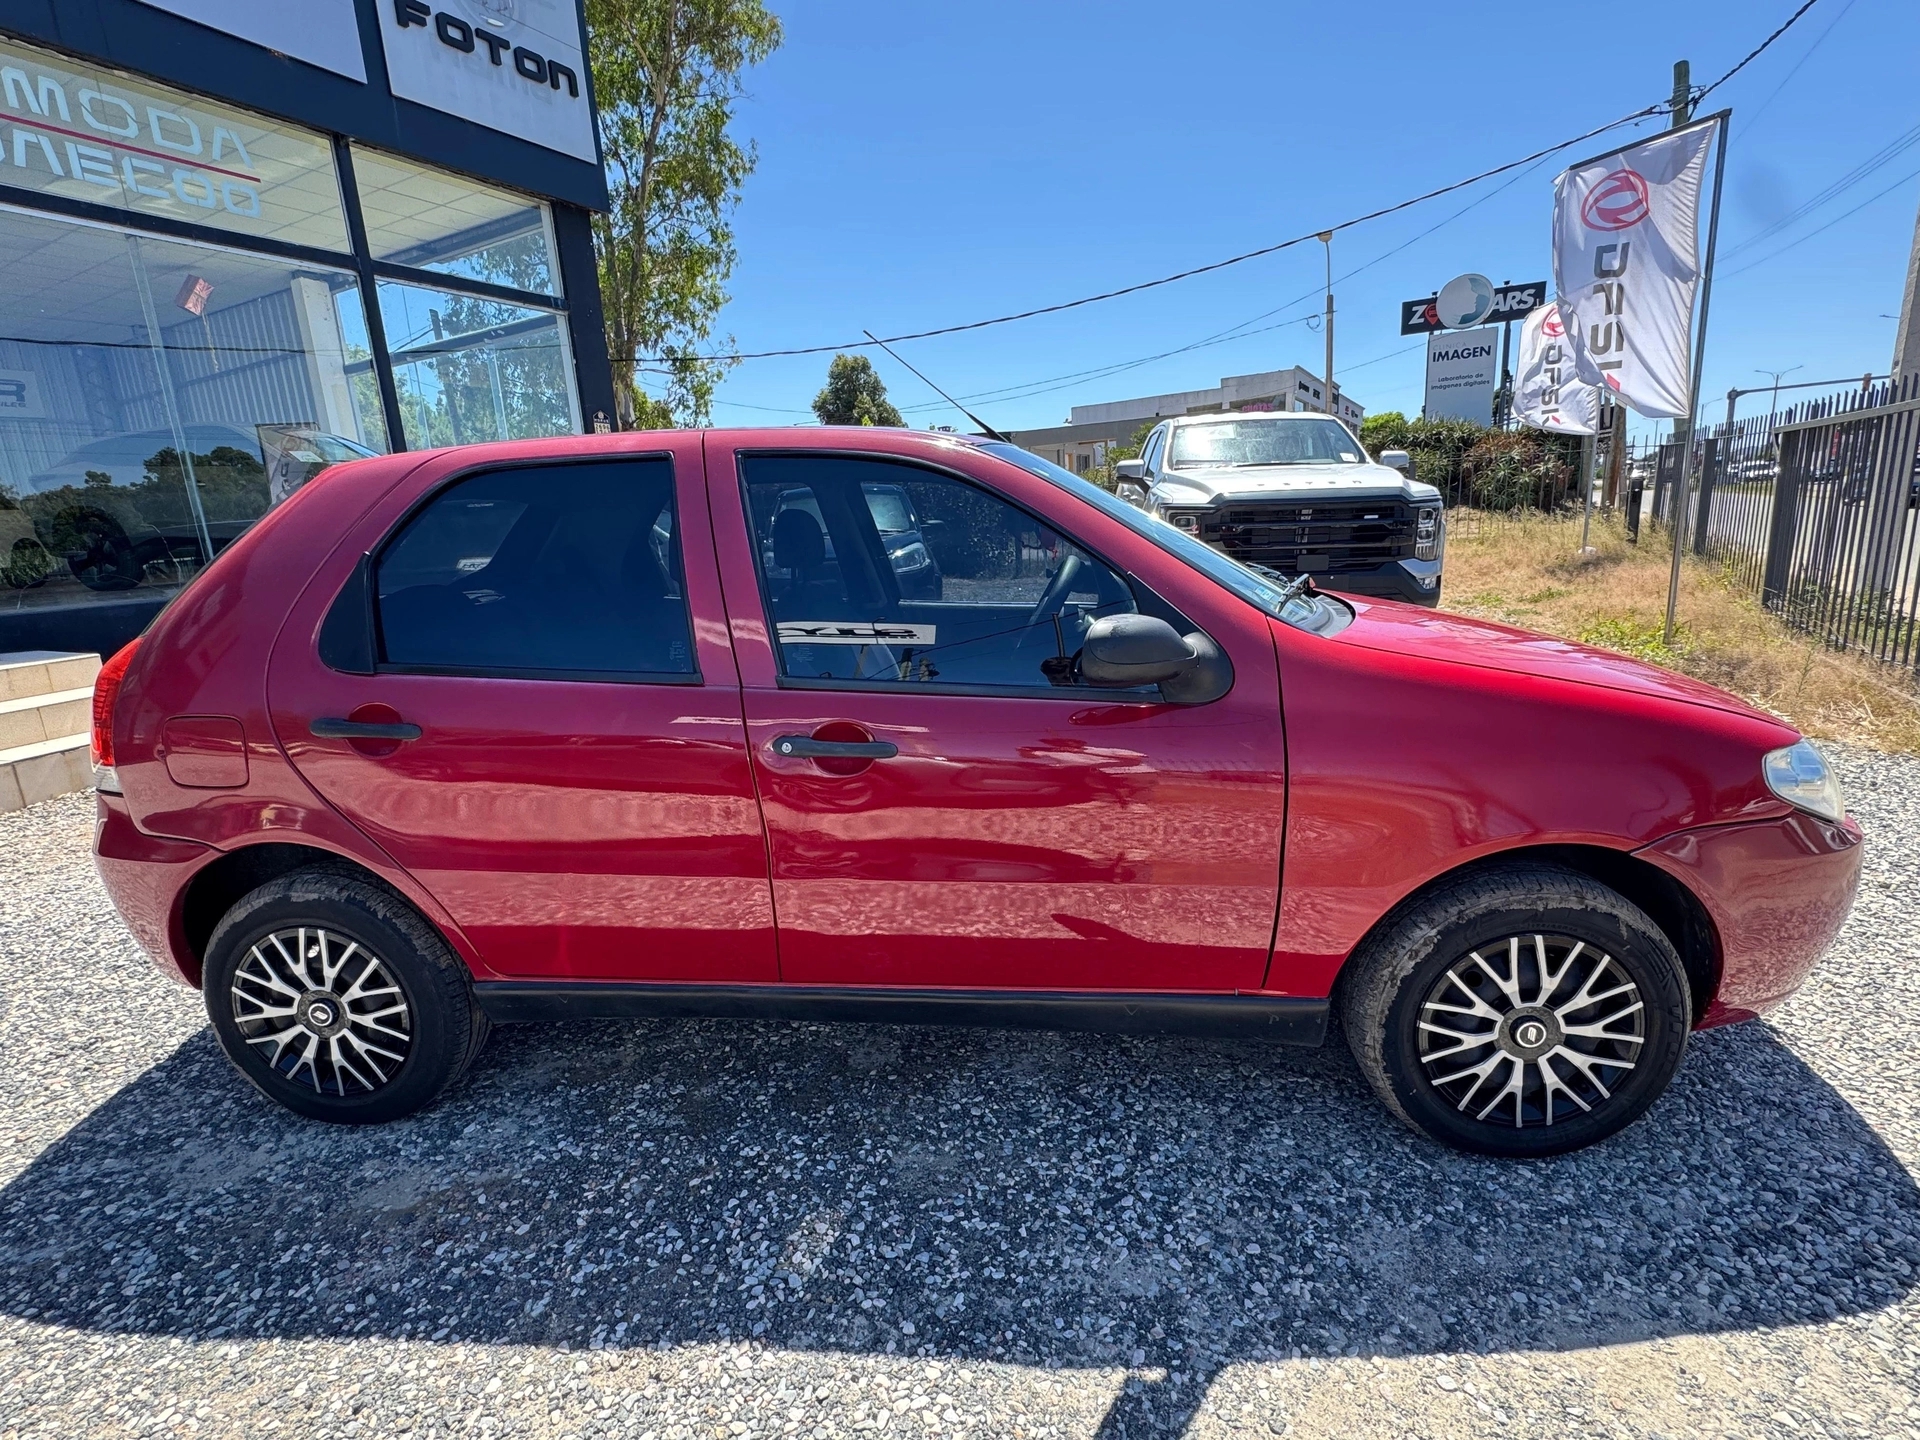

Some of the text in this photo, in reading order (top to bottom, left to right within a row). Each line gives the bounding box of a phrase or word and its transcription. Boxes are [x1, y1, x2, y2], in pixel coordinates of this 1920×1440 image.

[394, 0, 580, 98] FOTON
[0, 128, 262, 219] AECOO
[1433, 345, 1491, 362] IMAGEN
[1438, 374, 1474, 382] Laboratorio
